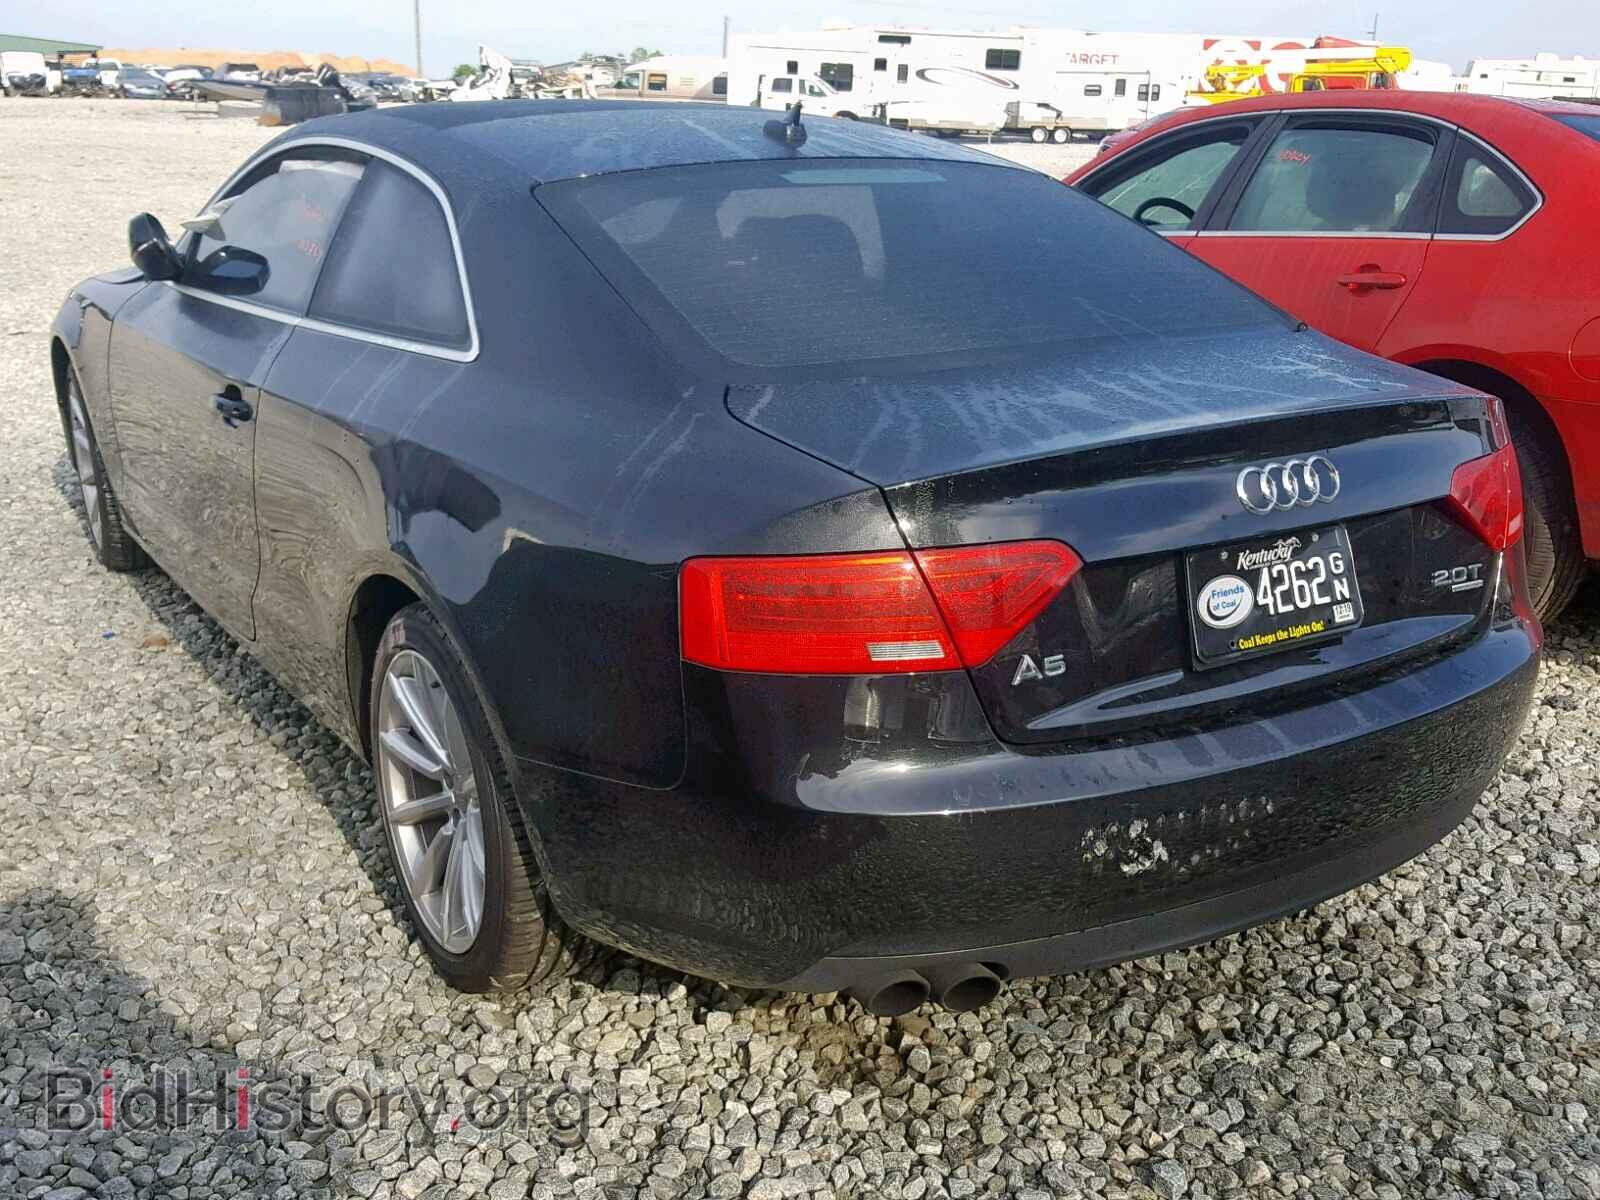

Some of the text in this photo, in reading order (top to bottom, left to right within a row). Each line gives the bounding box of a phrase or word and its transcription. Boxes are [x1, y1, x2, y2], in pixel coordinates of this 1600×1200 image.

[1236, 544, 1293, 570] Kentucky
[1211, 584, 1245, 599] Friends
[1257, 556, 1331, 615] 4262
[1221, 599, 1236, 609] Coal
[1239, 620, 1325, 650] Coal Keeps the Lights On!
[1011, 654, 1066, 685] A5
